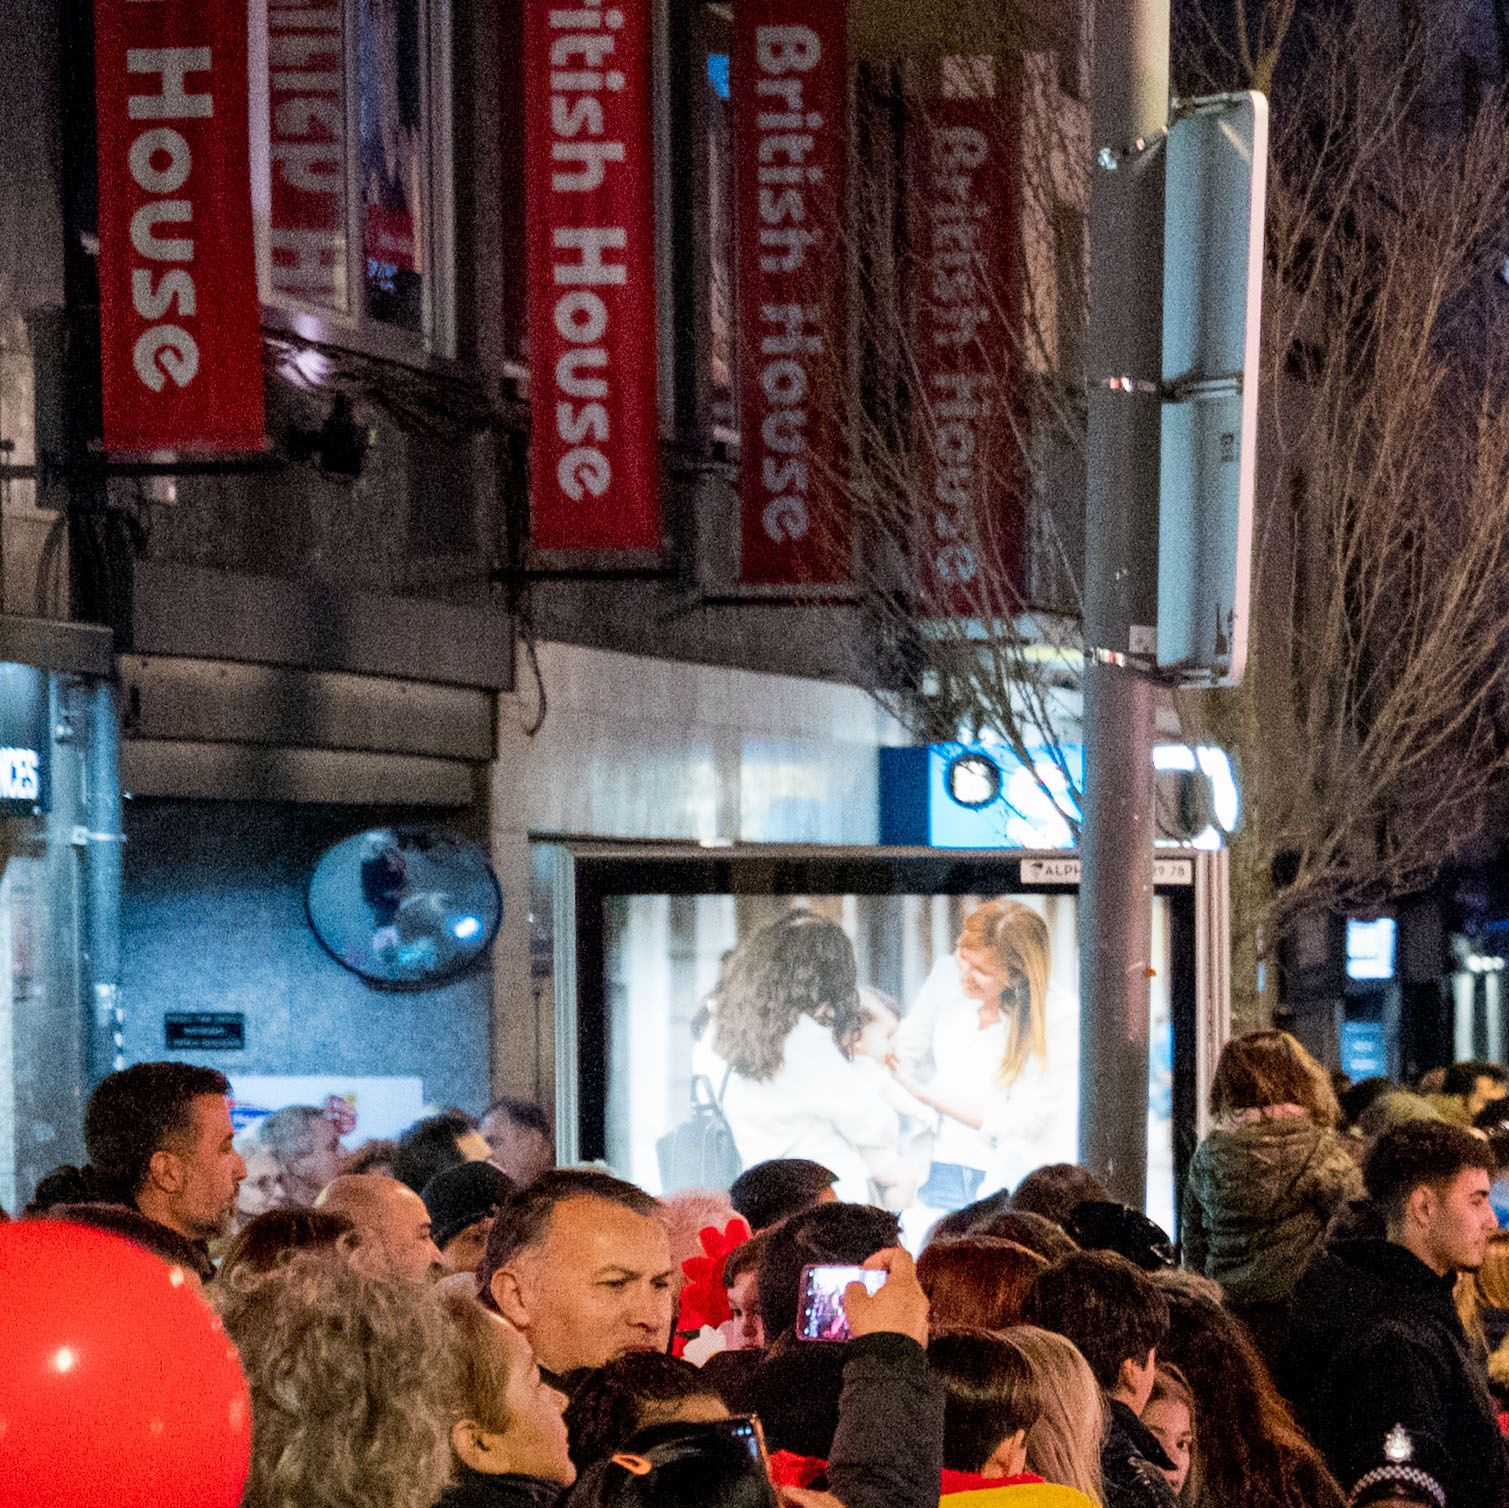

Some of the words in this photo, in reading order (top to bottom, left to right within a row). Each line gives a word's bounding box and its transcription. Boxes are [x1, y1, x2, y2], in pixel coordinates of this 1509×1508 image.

[549, 0, 625, 192] itish
[756, 24, 823, 273] British
[126, 46, 214, 395] House
[929, 126, 992, 343] British
[552, 226, 627, 502] House
[760, 302, 823, 542] House
[934, 373, 993, 583] House
